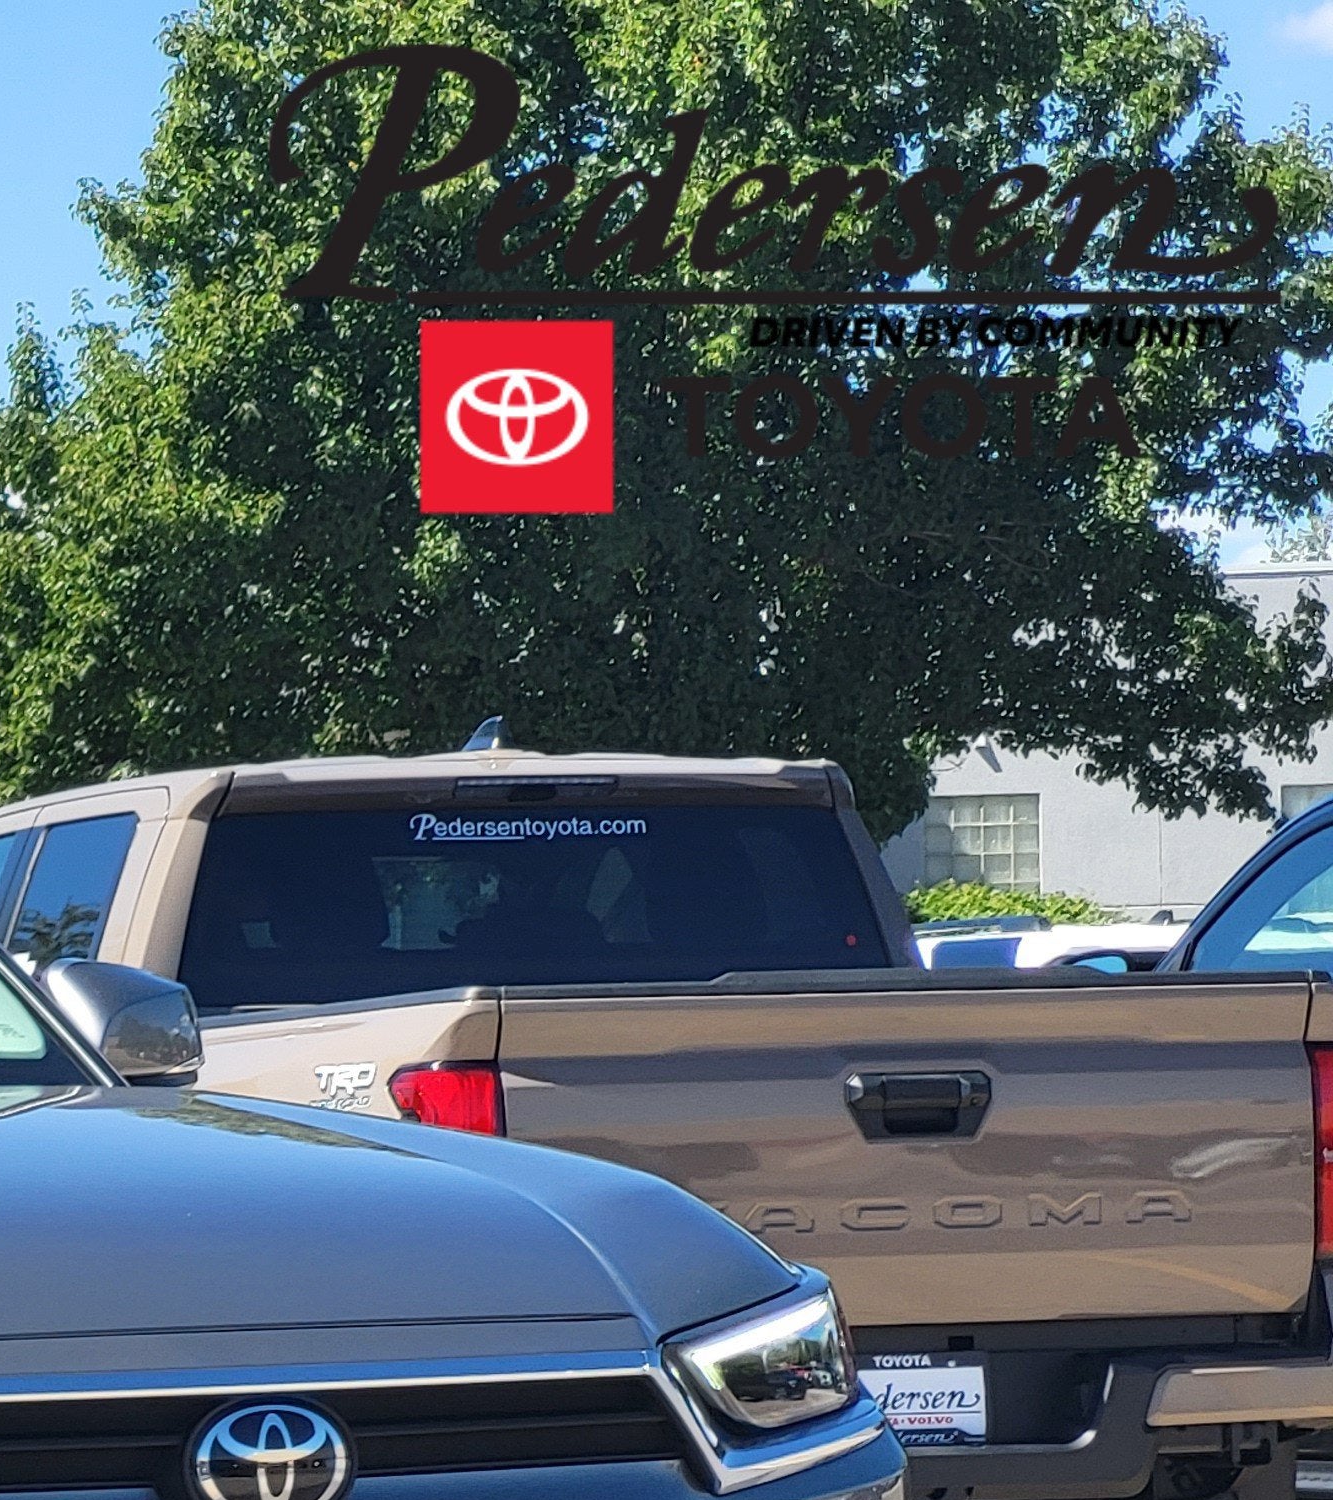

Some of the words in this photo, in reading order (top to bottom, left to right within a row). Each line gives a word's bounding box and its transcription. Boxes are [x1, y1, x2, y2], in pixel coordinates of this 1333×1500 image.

[409, 813, 647, 841] Pedersentoyota.com
[314, 1062, 378, 1098] TRD
[725, 1189, 1193, 1234] ACOMA
[872, 1354, 932, 1369] TOYOTA
[875, 1382, 981, 1412] dersen
